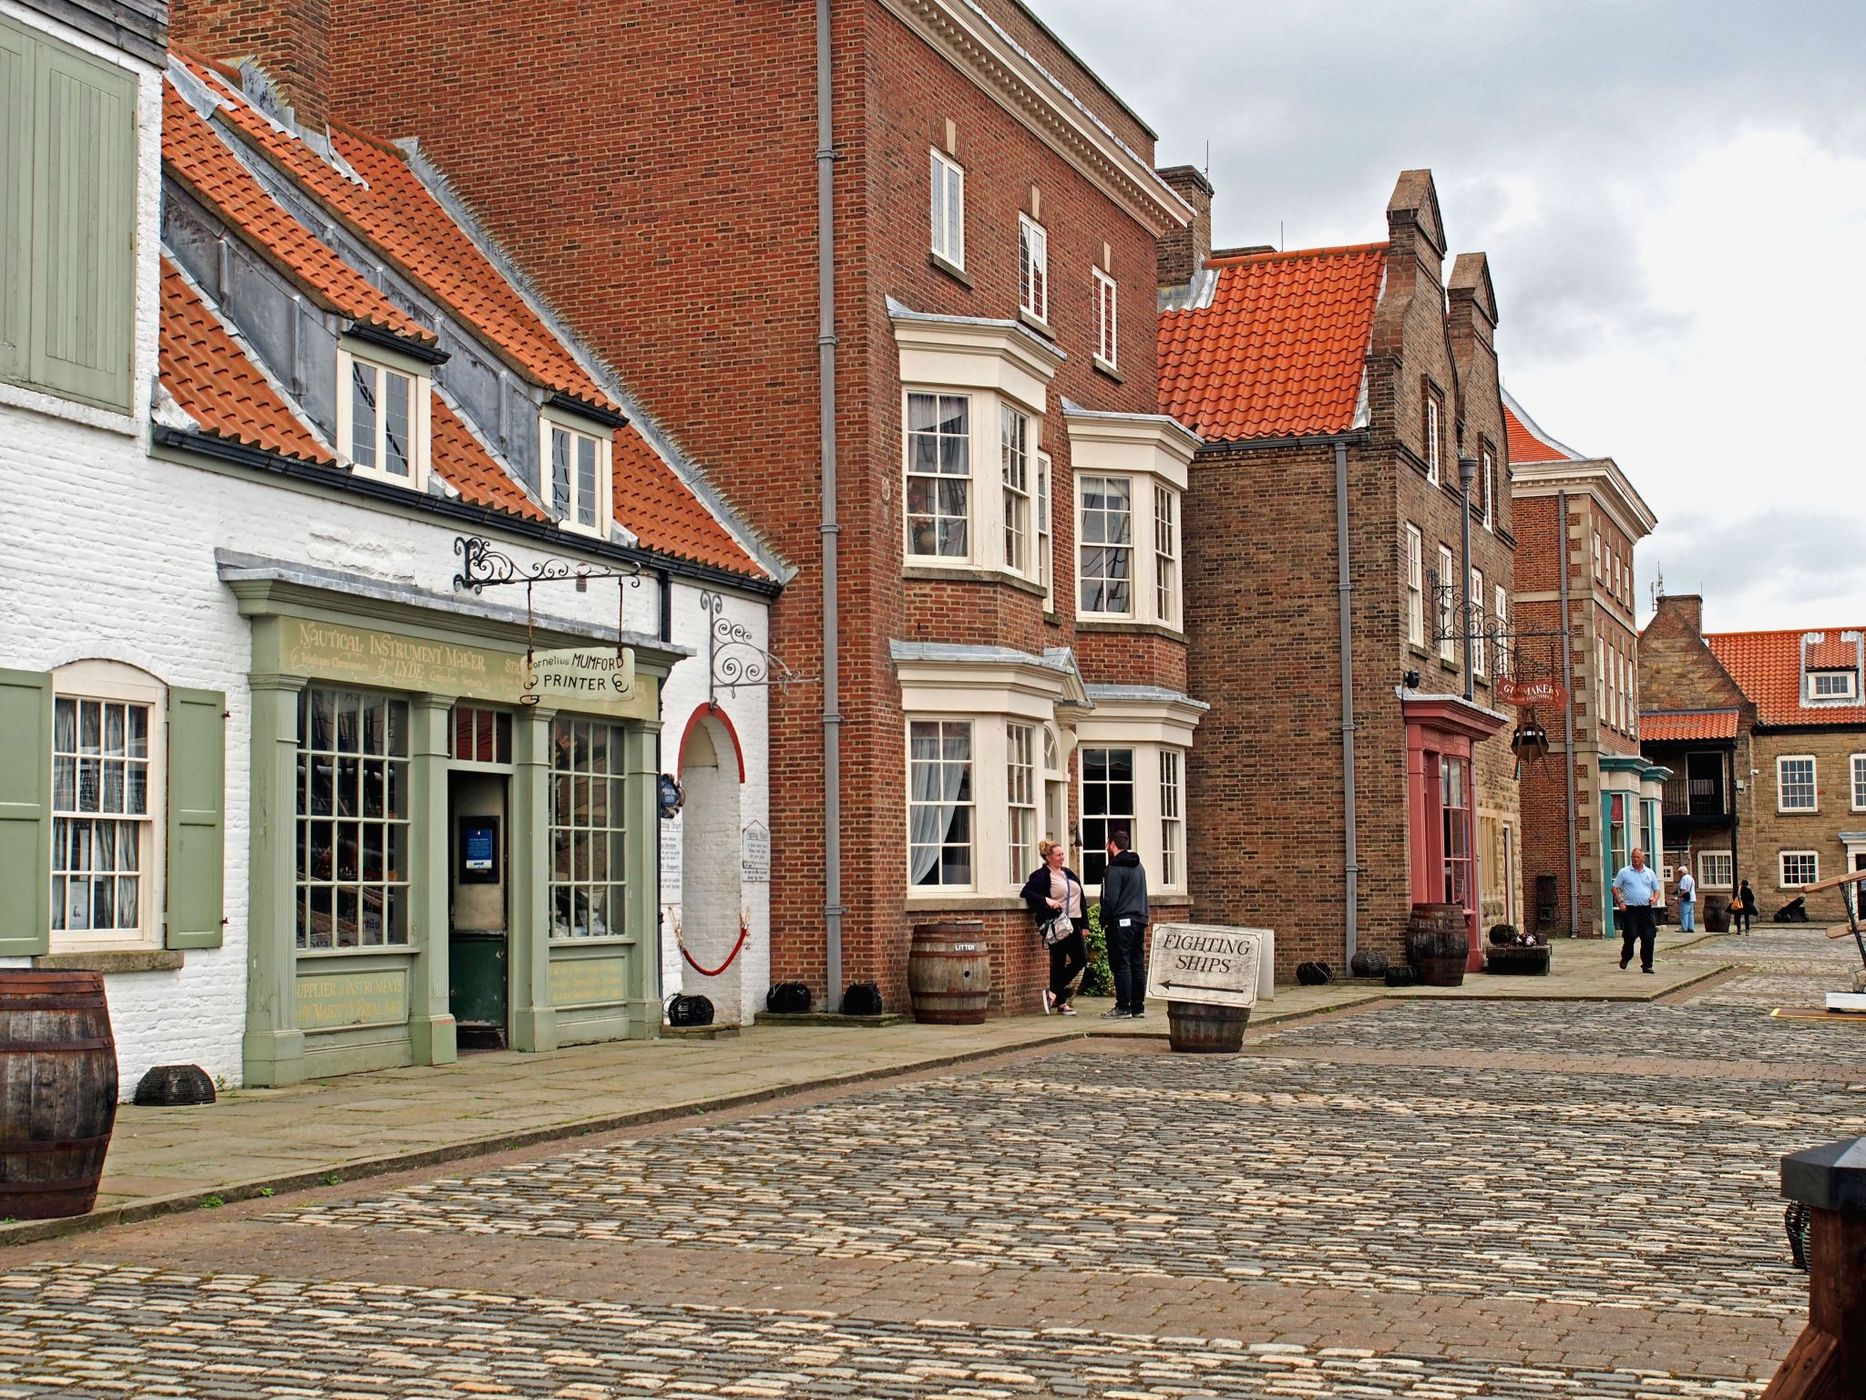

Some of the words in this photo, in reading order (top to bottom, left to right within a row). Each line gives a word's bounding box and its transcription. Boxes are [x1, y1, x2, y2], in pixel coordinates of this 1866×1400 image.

[300, 623, 364, 653] NAUTICAL
[369, 633, 443, 665] INSTRUMENT
[446, 647, 486, 672] MAKER
[395, 660, 424, 679] LYDE
[571, 653, 624, 671] MUMFORD
[543, 674, 606, 691] PRINTER
[1162, 933, 1251, 956] FIGHTING
[1175, 954, 1231, 974] SHIPS
[297, 982, 336, 999] UPPLIER
